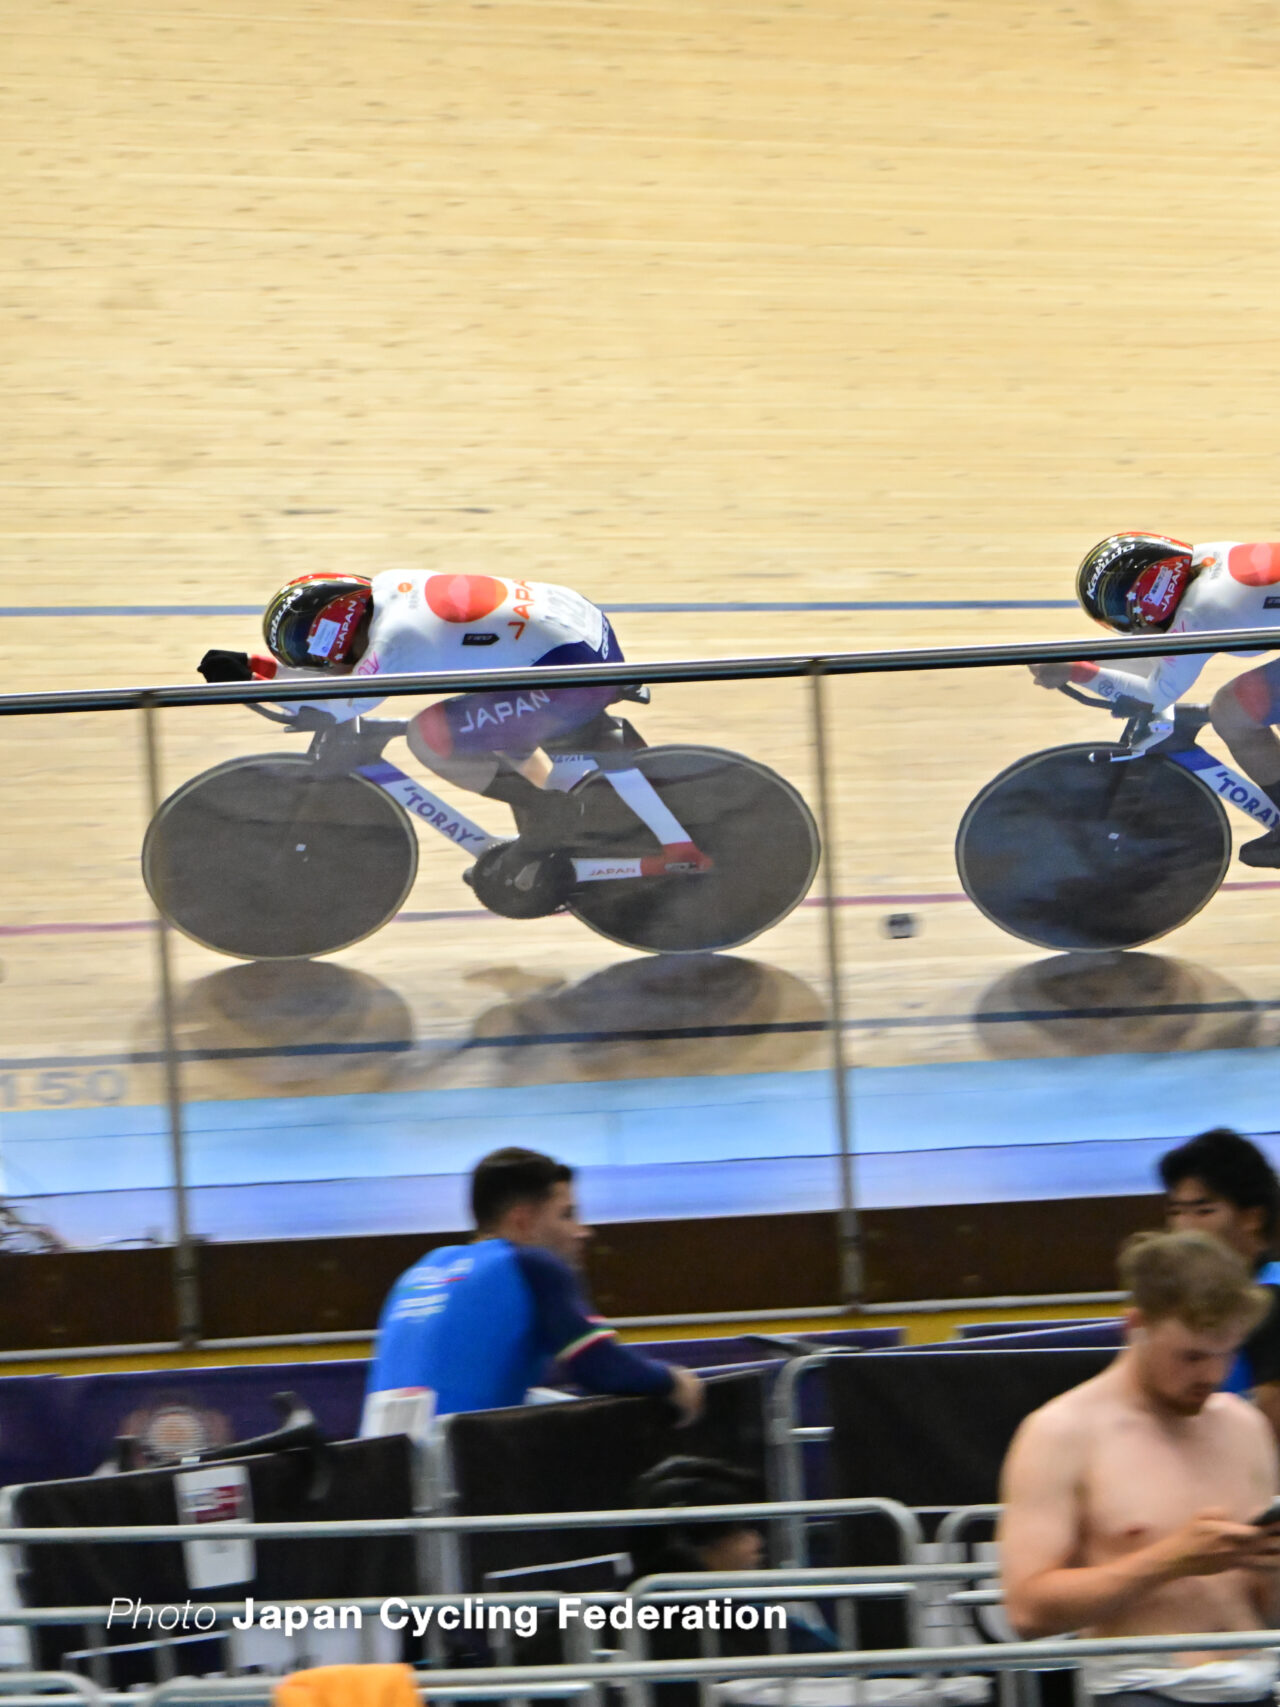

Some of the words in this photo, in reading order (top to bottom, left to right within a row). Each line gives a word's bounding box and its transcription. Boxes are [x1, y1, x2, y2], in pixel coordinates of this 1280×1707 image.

[1086, 543, 1136, 600] Kabuto
[1161, 561, 1185, 613] JAPAN
[337, 600, 358, 649] JAPAN
[459, 690, 551, 733] JAPAN
[588, 866, 637, 877] JAPAN
